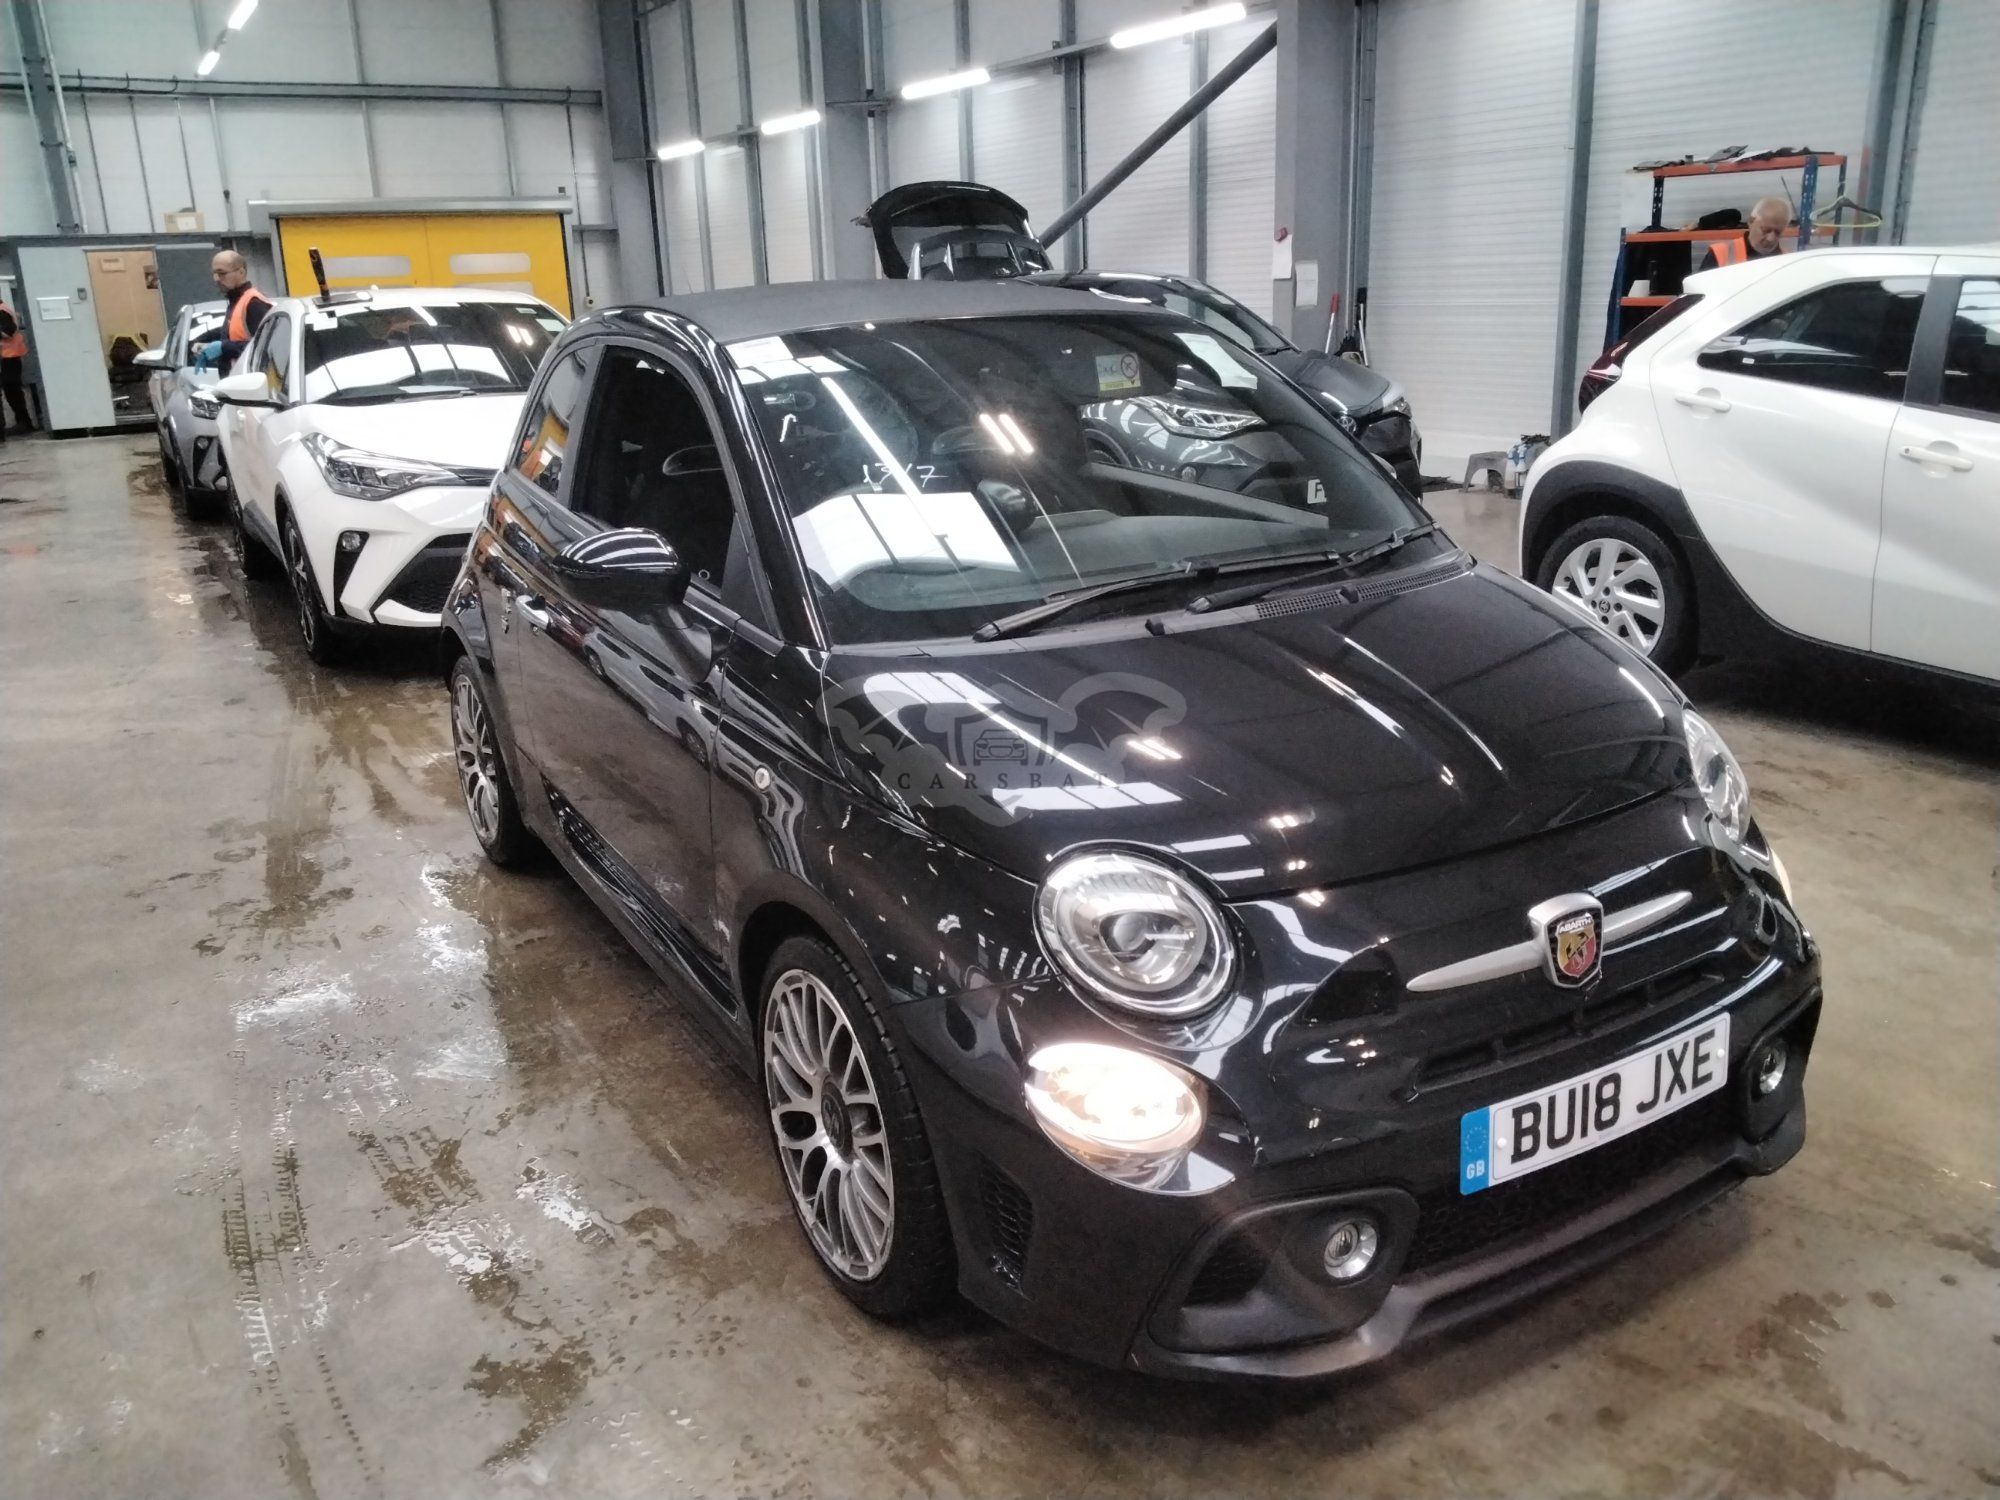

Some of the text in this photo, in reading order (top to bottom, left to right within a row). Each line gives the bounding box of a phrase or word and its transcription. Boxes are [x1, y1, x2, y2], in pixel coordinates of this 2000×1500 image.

[1560, 917, 1591, 932] ABARTH
[1511, 1029, 1716, 1164] BU18 JXE
[1466, 1160, 1485, 1180] GB
